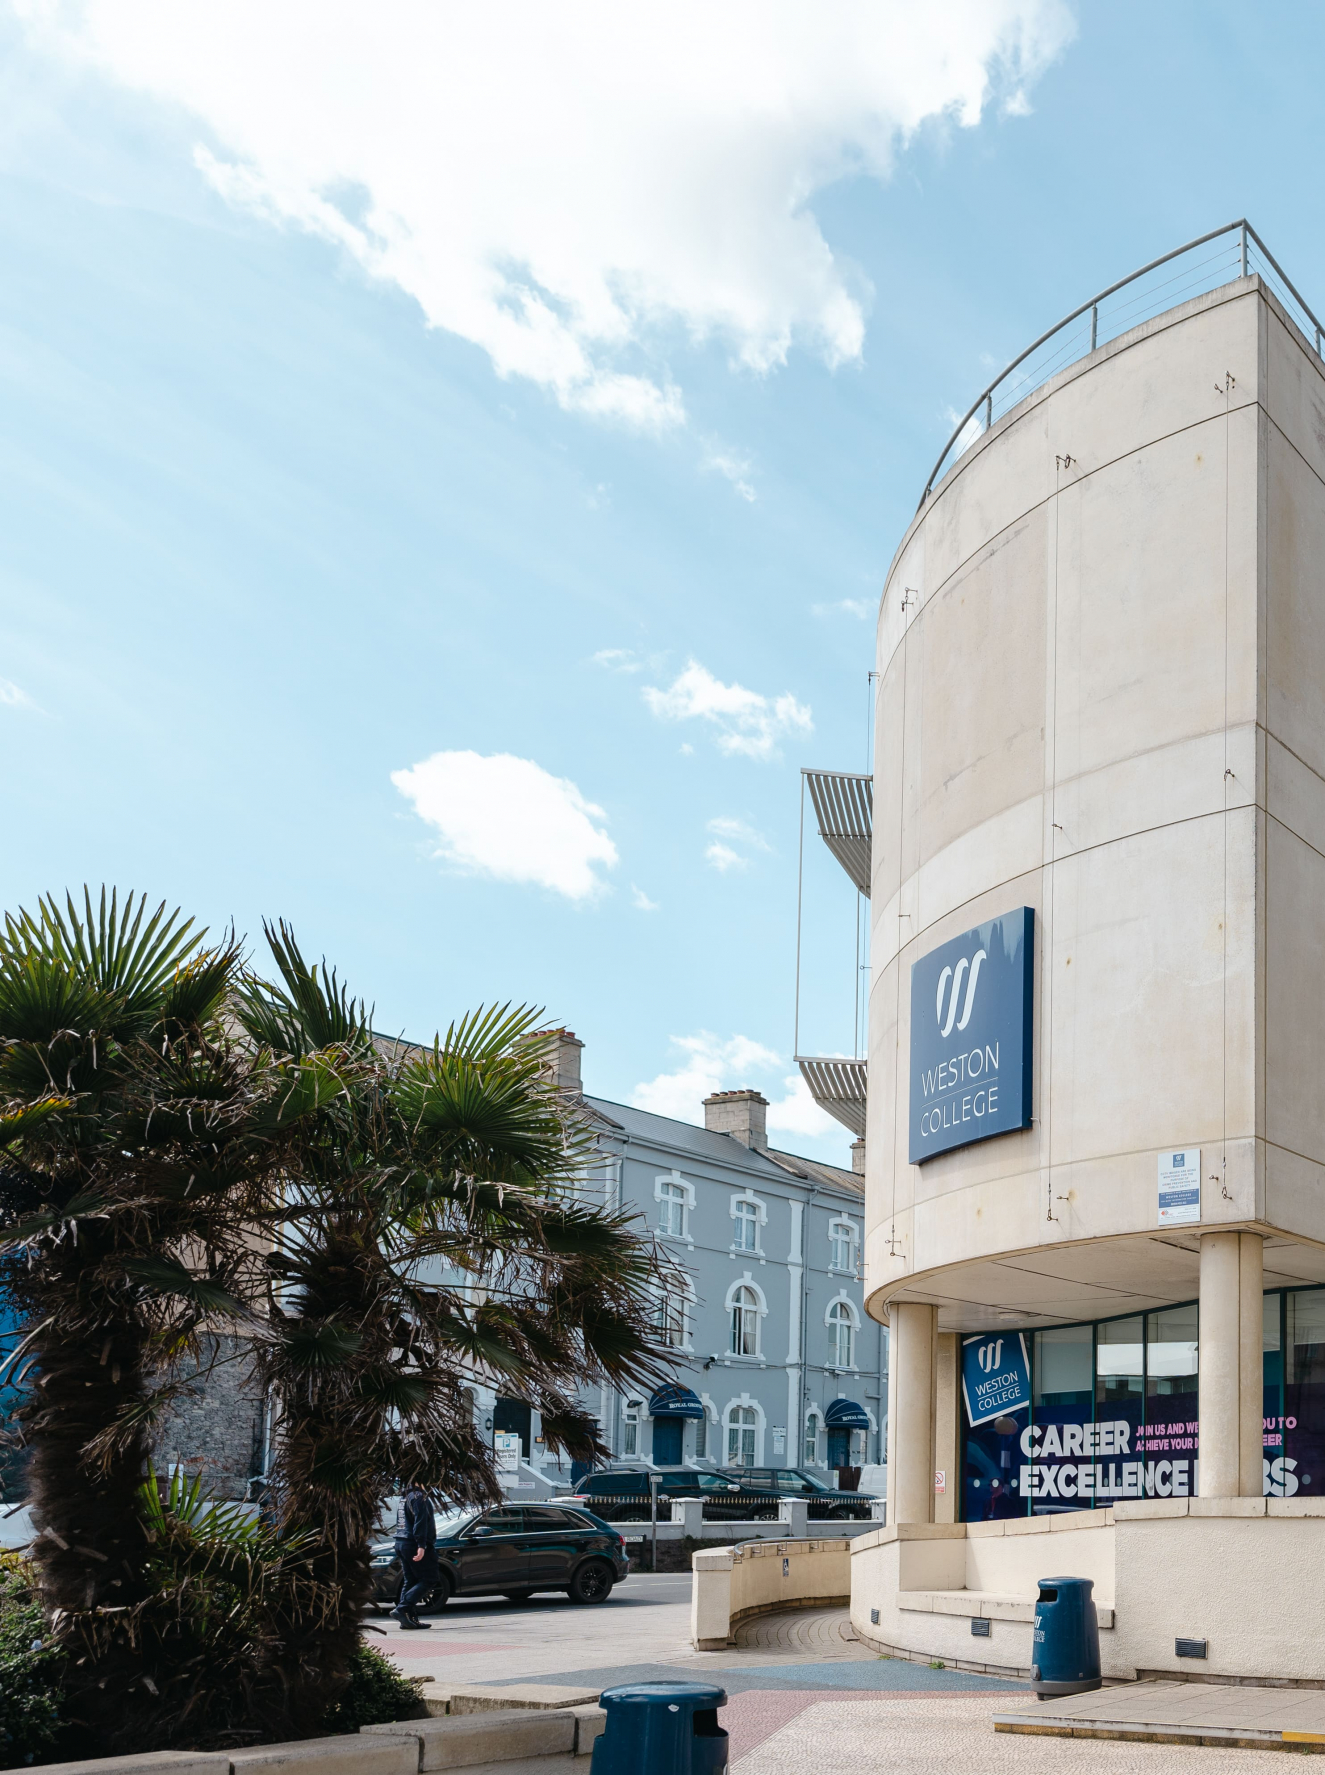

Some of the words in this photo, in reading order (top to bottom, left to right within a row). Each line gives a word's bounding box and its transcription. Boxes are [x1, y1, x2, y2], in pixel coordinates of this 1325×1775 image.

[920, 1041, 999, 1097] WESTON
[920, 1087, 999, 1137] COLLEGE
[975, 1370, 1019, 1397] WESTON
[978, 1388, 1021, 1411] COLLEGE
[1019, 1420, 1131, 1458] CAREER
[1135, 1425, 1154, 1437] JOIN
[1155, 1424, 1166, 1436] US
[1167, 1422, 1185, 1435] AND
[1277, 1416, 1298, 1430] TO
[1135, 1438, 1170, 1452] ACHIEVE
[1170, 1438, 1193, 1450] YOUR
[1019, 1459, 1189, 1498] EXCELLENCE
